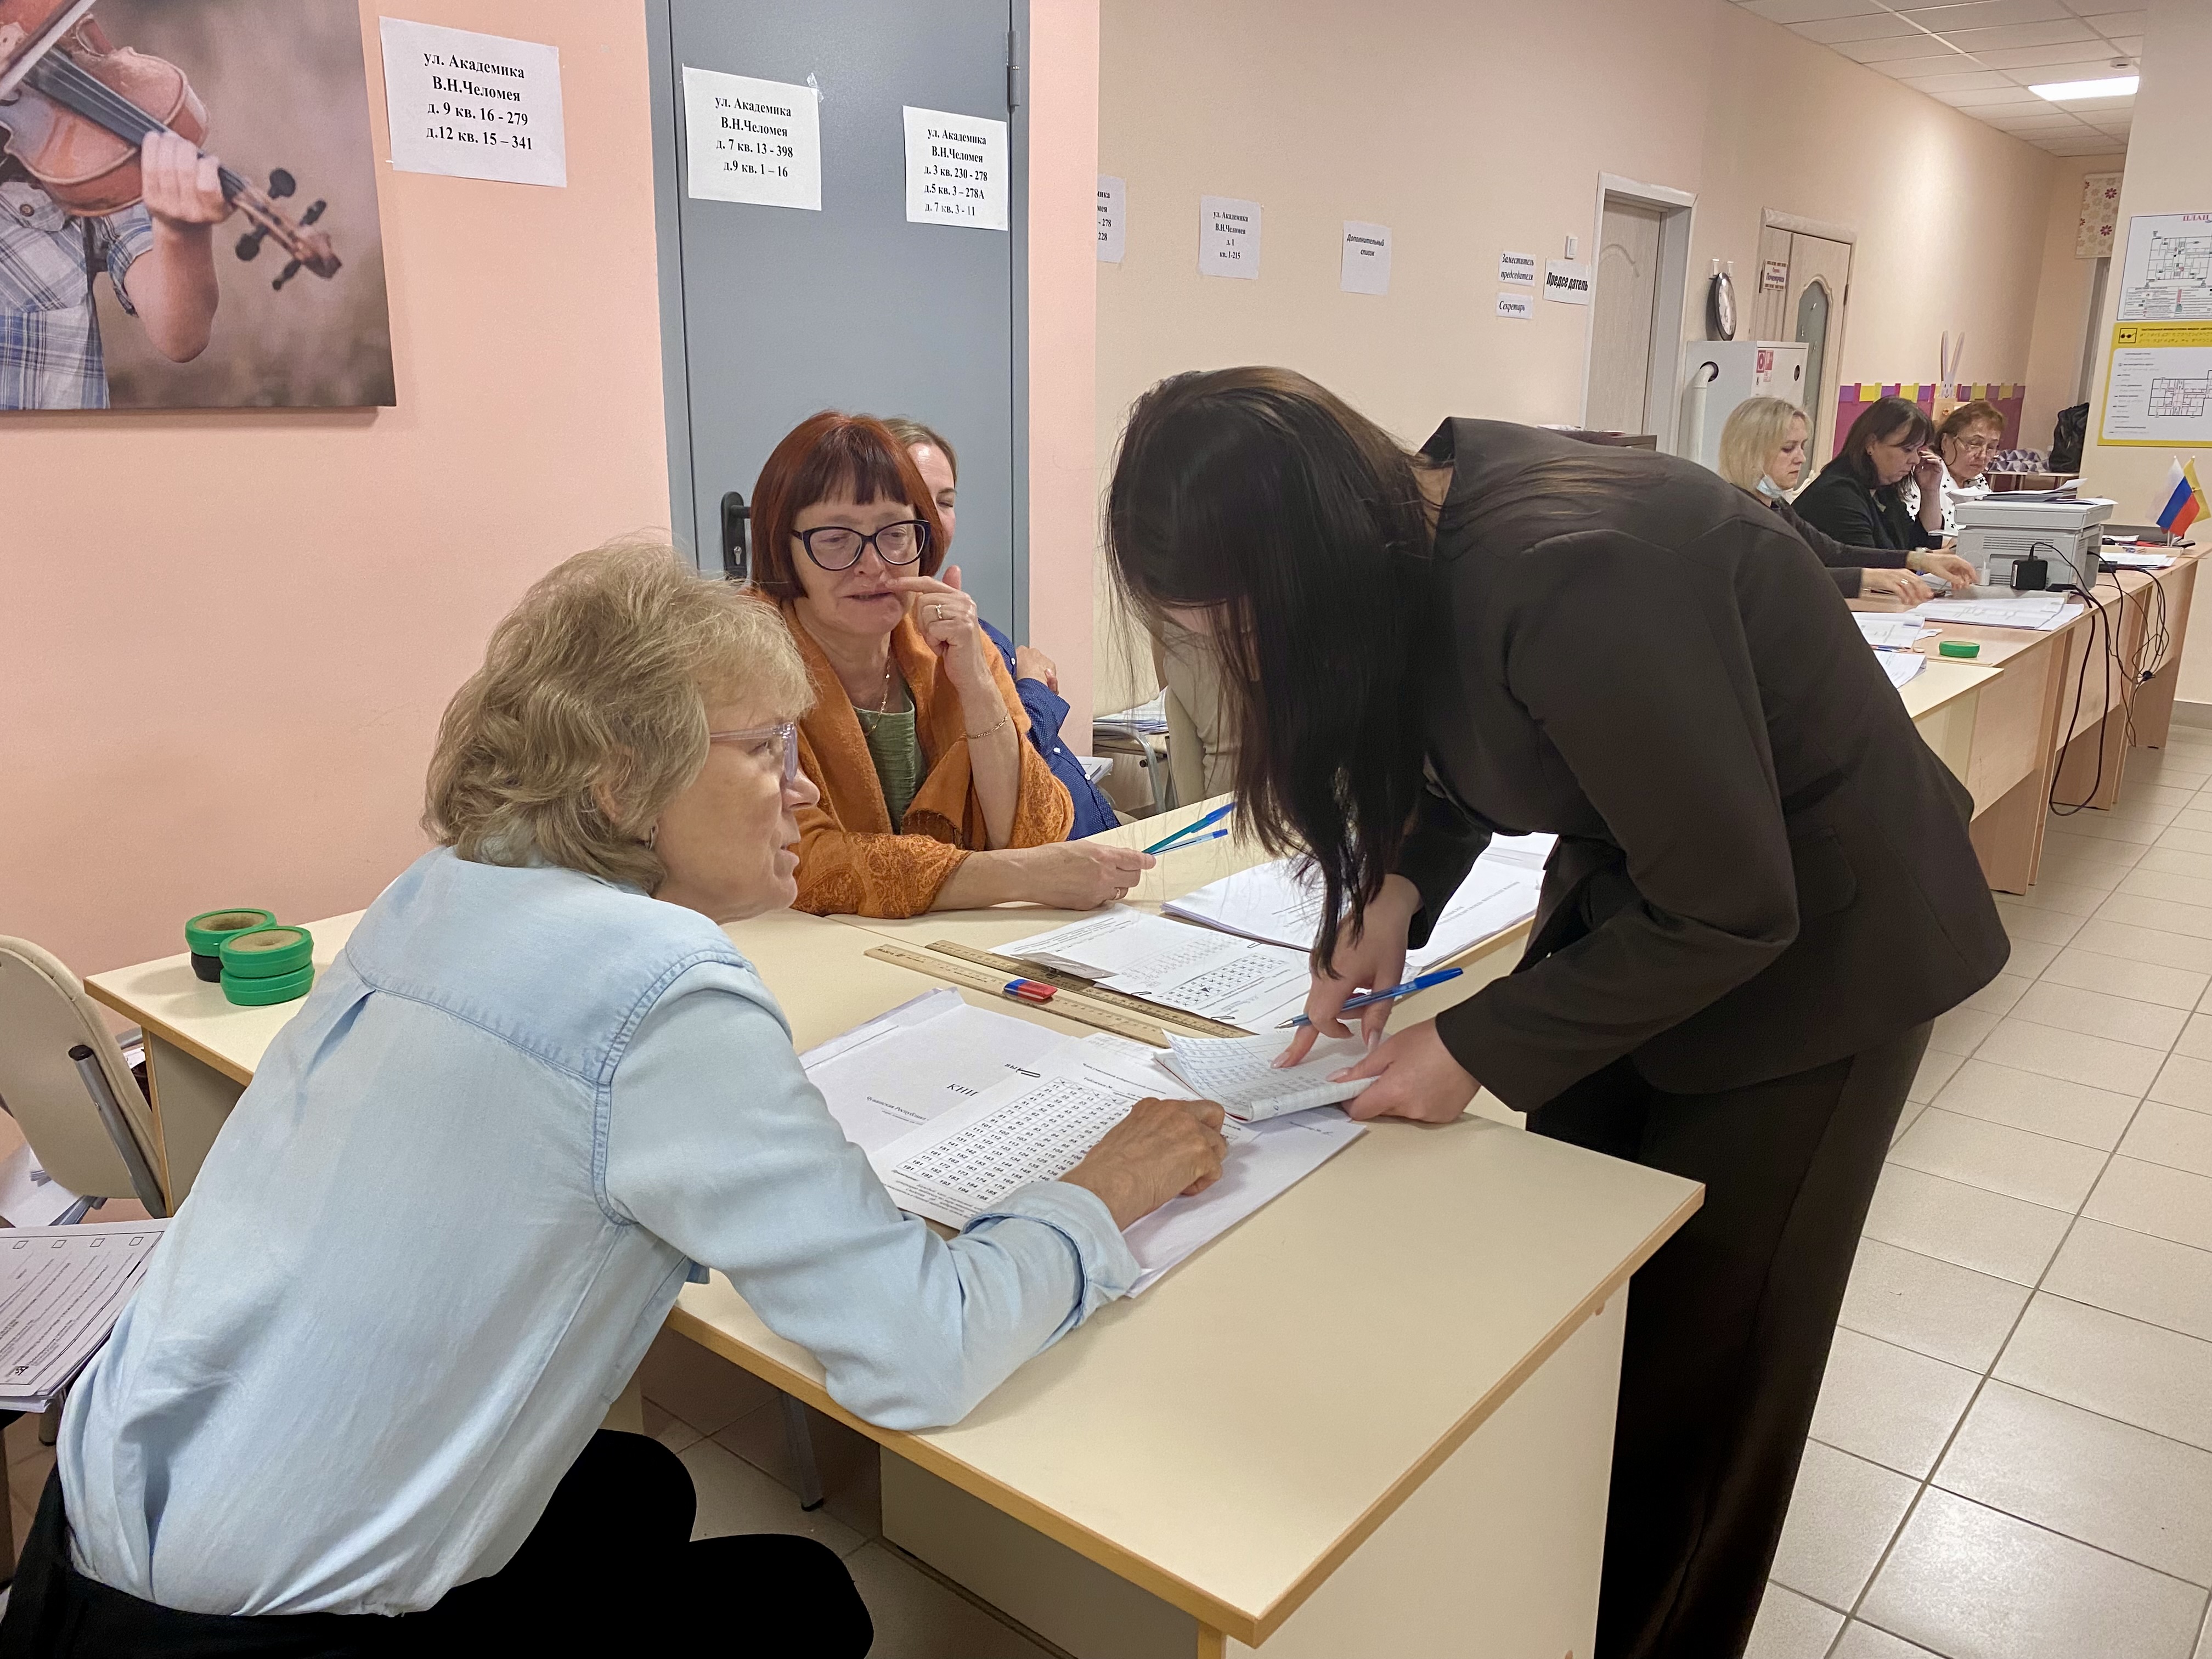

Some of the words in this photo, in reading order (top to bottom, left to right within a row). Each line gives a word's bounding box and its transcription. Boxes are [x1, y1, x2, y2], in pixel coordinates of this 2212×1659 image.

[424, 53, 445, 66] ул.
[449, 55, 524, 78] Академика
[433, 76, 521, 101] В.Н.Челомея
[427, 103, 439, 114] д.
[443, 102, 450, 115] 9
[455, 105, 476, 119] кв.
[481, 108, 494, 121] 16
[507, 111, 528, 126] 279
[715, 97, 731, 109] ул.
[734, 98, 791, 116] Академика
[721, 117, 787, 137] В.Н.Челомея
[426, 126, 453, 139] д.12
[458, 131, 478, 143] кв.
[483, 132, 497, 145] 15
[511, 136, 532, 150] 341
[928, 129, 939, 139] ул.
[942, 129, 986, 145] Академика
[716, 140, 725, 149] д.
[729, 139, 734, 150] 7
[737, 143, 753, 153] кв.
[757, 143, 766, 154] 13
[777, 146, 793, 157] 398
[932, 146, 983, 162] В.Н.Челомея
[724, 160, 738, 171] д.9
[742, 164, 757, 174] кв.
[761, 164, 764, 174] 1
[778, 166, 788, 177] 16
[924, 166, 931, 174] д.
[933, 165, 938, 174] 3
[940, 168, 952, 177] кв.
[955, 168, 968, 179] 230
[975, 171, 988, 181] 278
[924, 184, 935, 193] д.5
[939, 187, 950, 195] кв.
[952, 186, 957, 195] 3
[934, 202, 938, 212] 7
[955, 205, 959, 214] 3
[968, 206, 974, 216] 11
[1499, 301, 1525, 312] Секретарь
